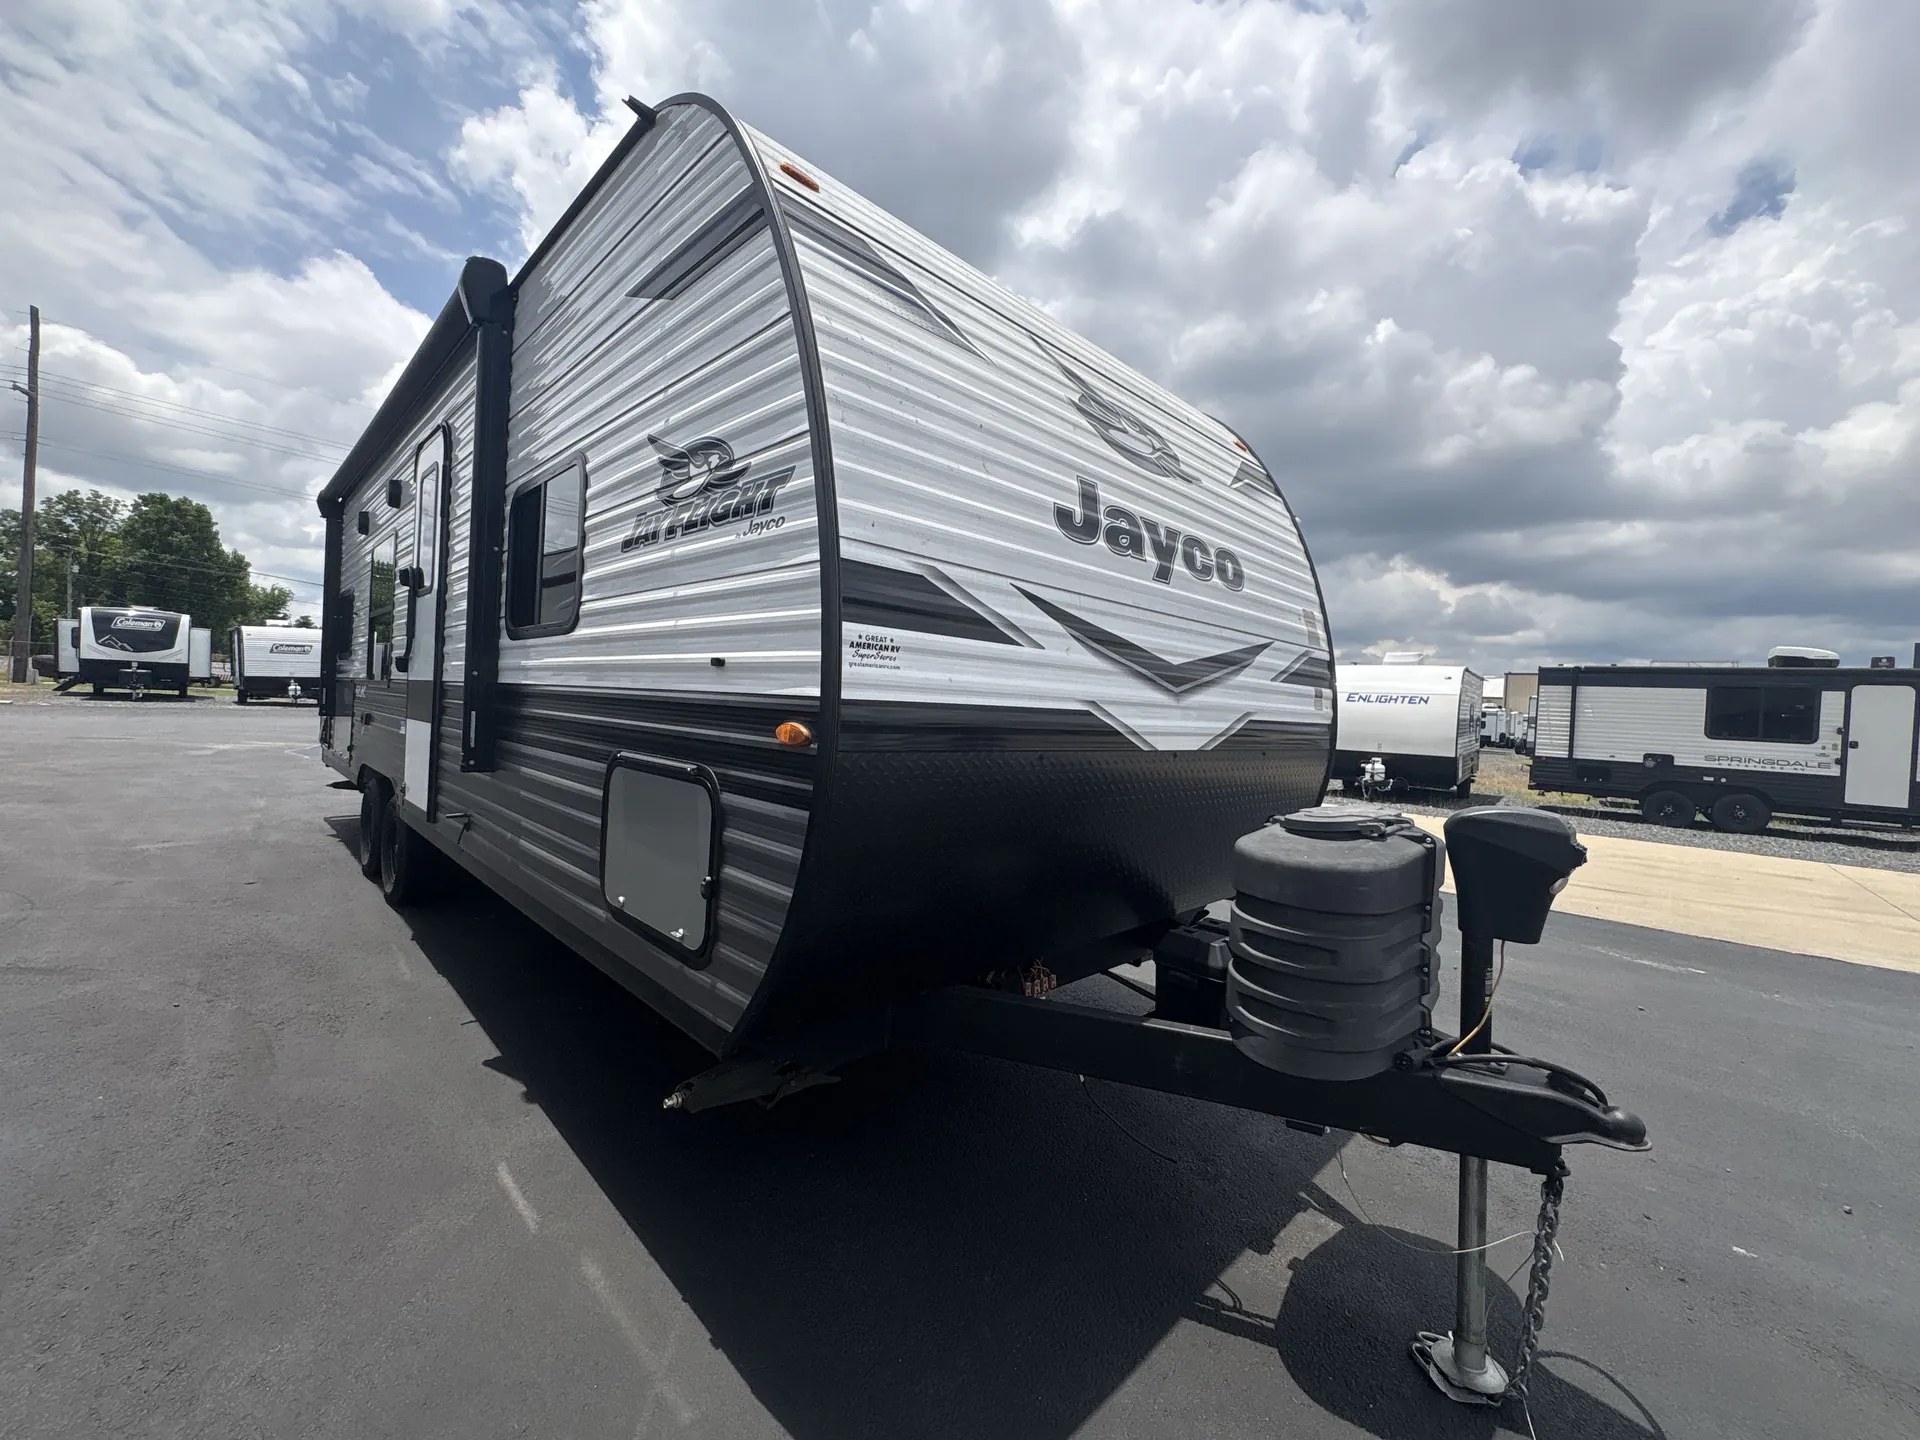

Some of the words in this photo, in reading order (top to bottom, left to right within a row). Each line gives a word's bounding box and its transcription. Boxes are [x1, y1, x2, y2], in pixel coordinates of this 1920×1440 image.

[743, 516, 785, 536] Jayco
[1053, 475, 1245, 592] Jayco
[116, 618, 154, 628] Coleman
[865, 635, 888, 643] GREAT
[272, 644, 304, 653] Coleman
[849, 641, 890, 652] AMERICAN
[890, 645, 901, 653] RV
[848, 661, 901, 671] greatamericanrv.com
[1346, 692, 1430, 705] ENLIGHTEN
[1704, 755, 1832, 769] SPRINGDALE
